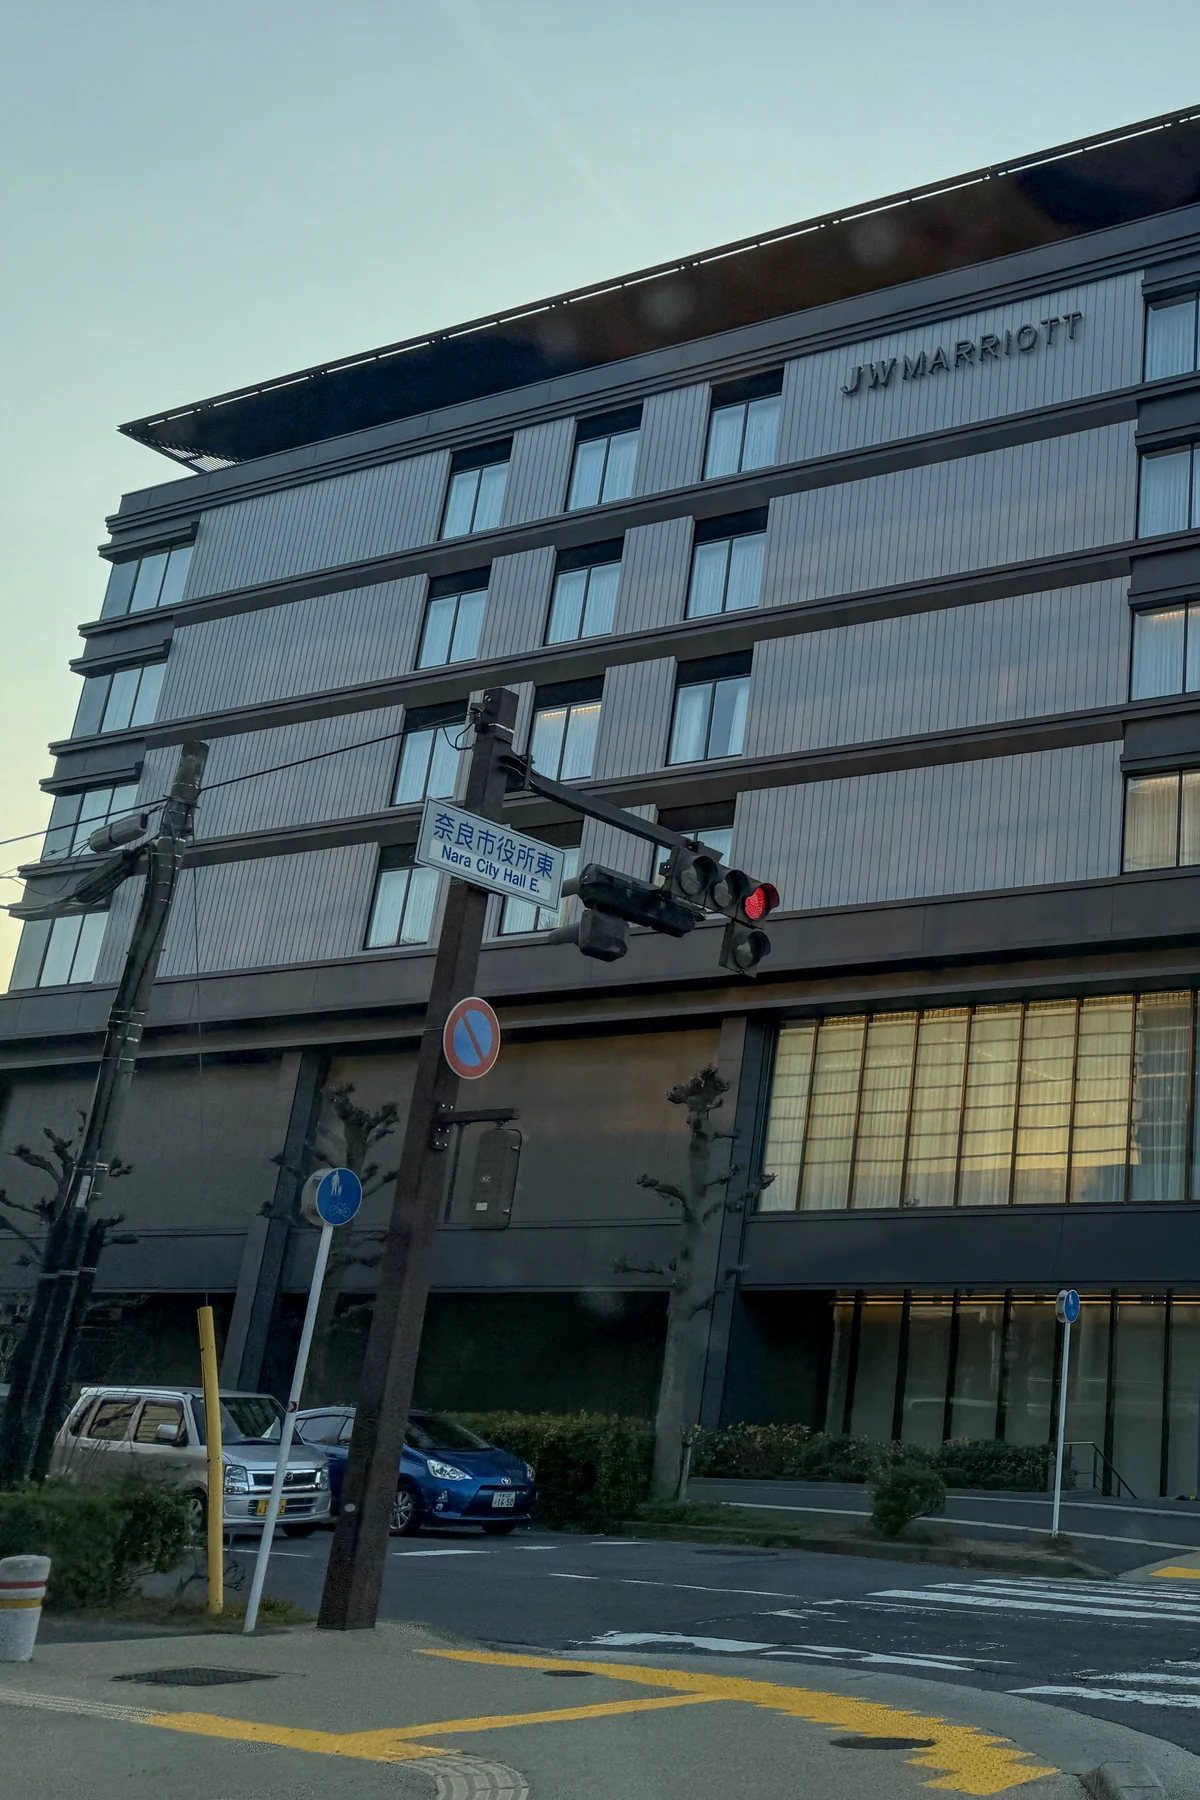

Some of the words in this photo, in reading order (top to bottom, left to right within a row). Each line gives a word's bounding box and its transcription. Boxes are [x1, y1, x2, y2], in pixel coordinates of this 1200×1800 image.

[433, 812, 555, 880] 奈良市役所東
[441, 845, 471, 868] Nara
[476, 858, 500, 880] City
[503, 870, 527, 888] Hall
[529, 879, 540, 894] E.
